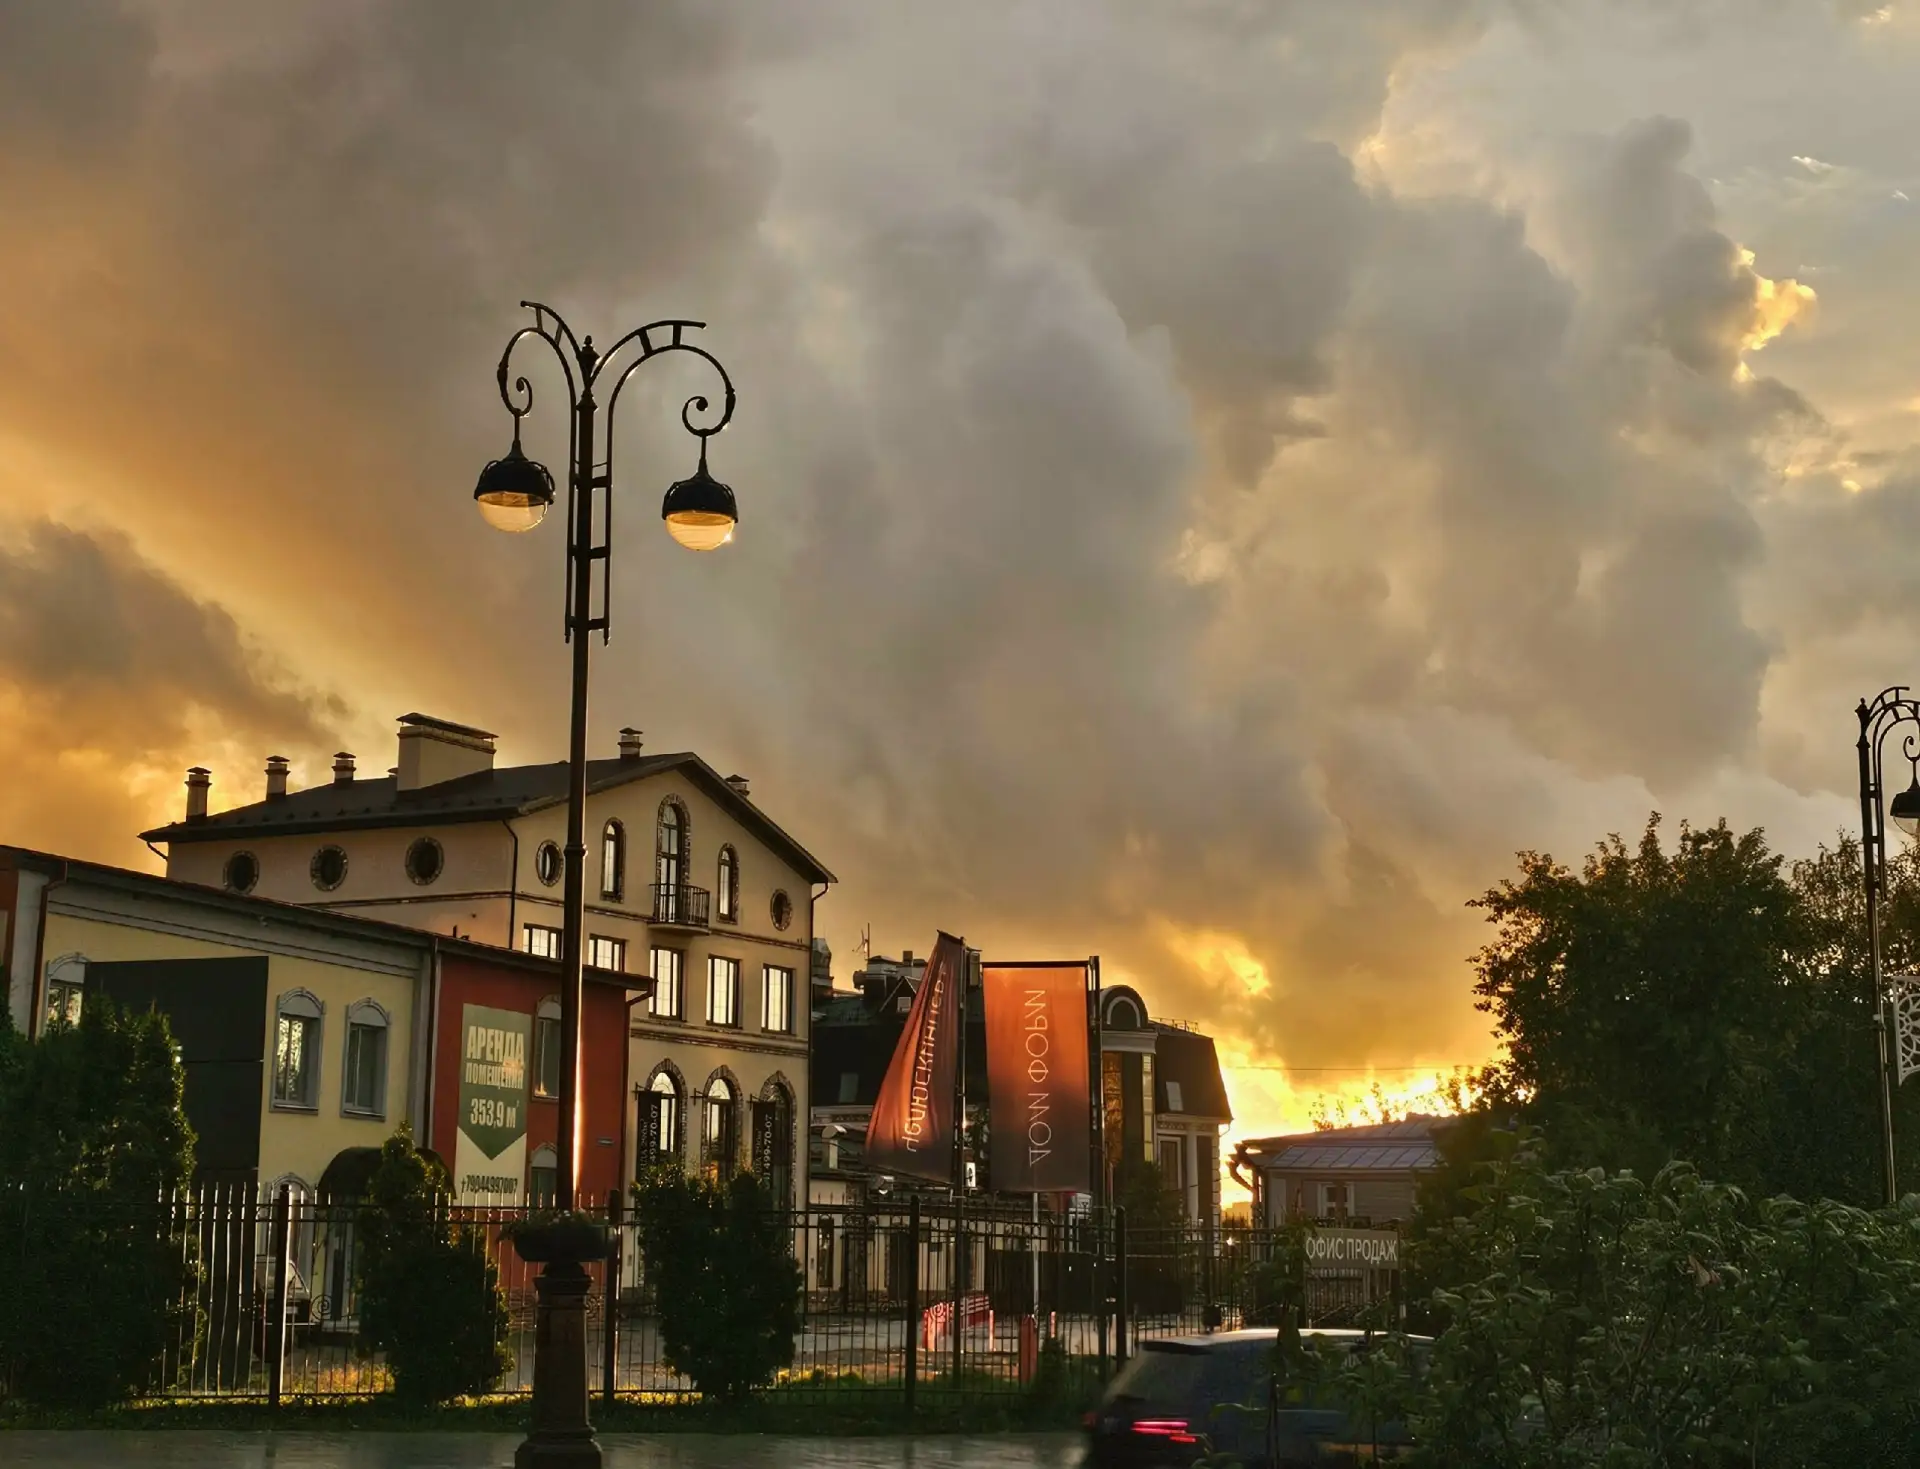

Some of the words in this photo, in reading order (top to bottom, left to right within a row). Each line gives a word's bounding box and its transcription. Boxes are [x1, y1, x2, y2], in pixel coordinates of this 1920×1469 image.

[466, 1025, 525, 1067] АРЕНДА
[470, 1098, 504, 1129] 353,9
[1305, 1236, 1344, 1260] ОФИС
[1346, 1238, 1398, 1265] ПРОДАЖ
